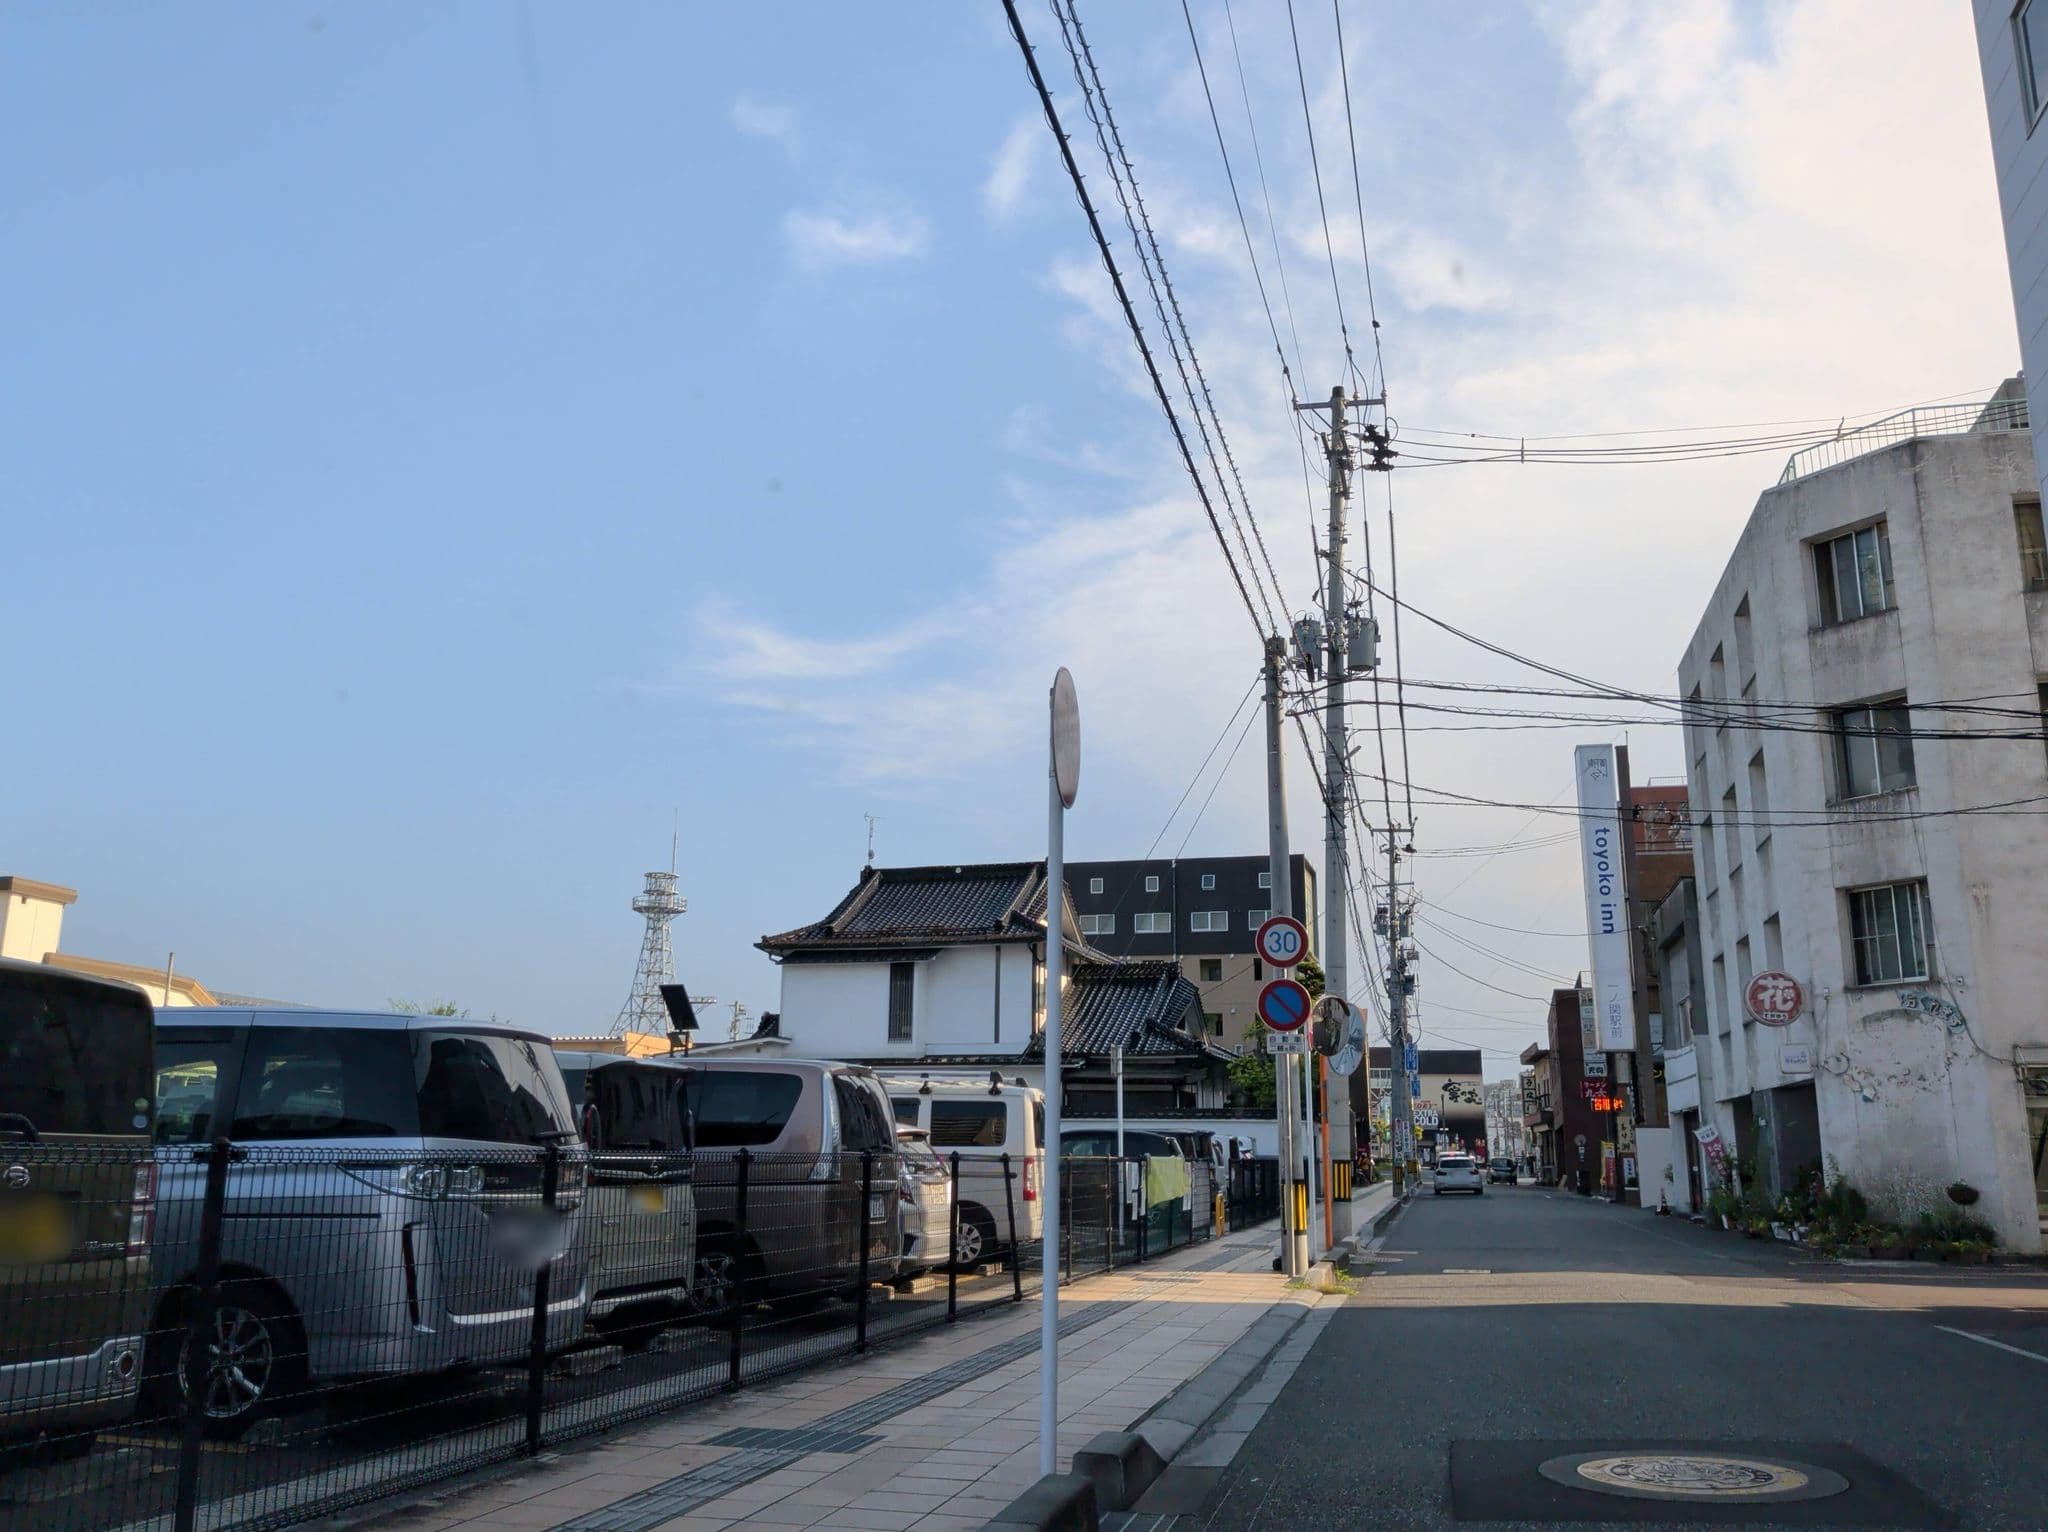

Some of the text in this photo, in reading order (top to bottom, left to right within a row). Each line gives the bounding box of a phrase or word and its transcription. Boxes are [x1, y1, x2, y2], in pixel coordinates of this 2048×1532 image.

[1594, 827, 1615, 935] toyoko inn
[1269, 931, 1297, 953] 30
[1607, 984, 1623, 1039] 一ノ関駅前
[1583, 1078, 1607, 1088] ラーメン
[1413, 1109, 1439, 1117] EXTRA
[1413, 1116, 1439, 1126] COLD
